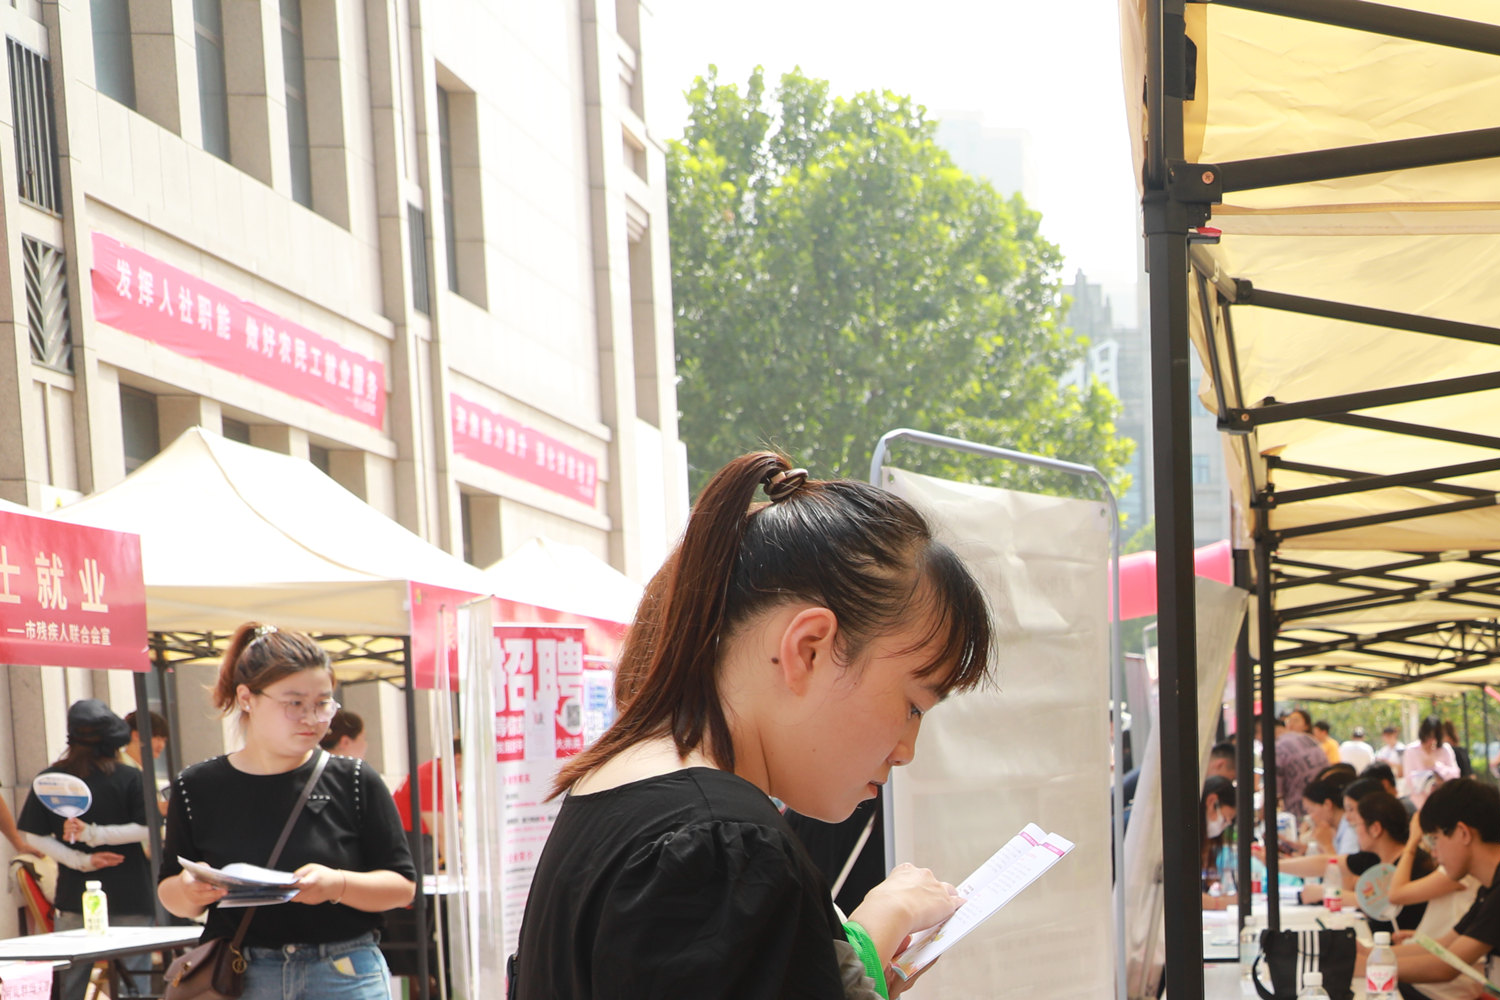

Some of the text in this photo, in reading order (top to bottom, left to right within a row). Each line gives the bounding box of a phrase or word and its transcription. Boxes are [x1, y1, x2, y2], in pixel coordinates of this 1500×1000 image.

[116, 258, 232, 341] 发挥人社职能
[494, 637, 583, 712] 招聘
